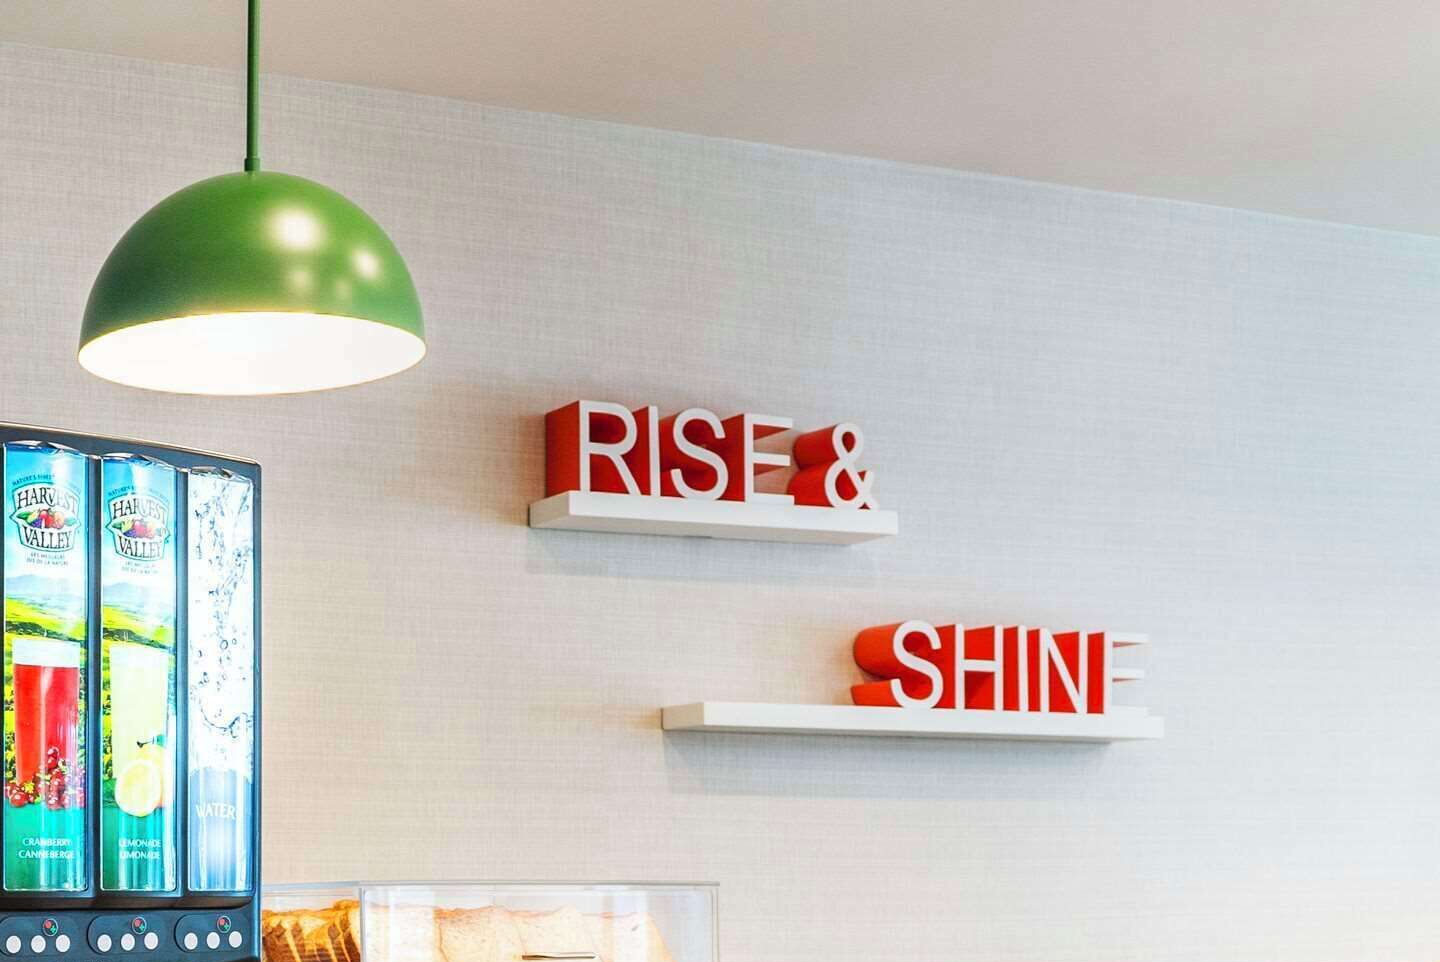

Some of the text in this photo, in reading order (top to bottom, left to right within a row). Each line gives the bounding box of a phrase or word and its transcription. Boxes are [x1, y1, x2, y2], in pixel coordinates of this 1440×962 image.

[578, 399, 879, 511] RISE &
[17, 486, 78, 514] HARVEST
[113, 498, 167, 525] HARVEST
[22, 523, 72, 549] VALLEY
[117, 535, 163, 558] VALLEY
[890, 619, 1150, 717] SHINE
[195, 802, 237, 821] WATER
[22, 837, 72, 847] CRANBERRY
[118, 839, 162, 849] LEMONADE
[18, 849, 76, 860] CANNEBERGE
